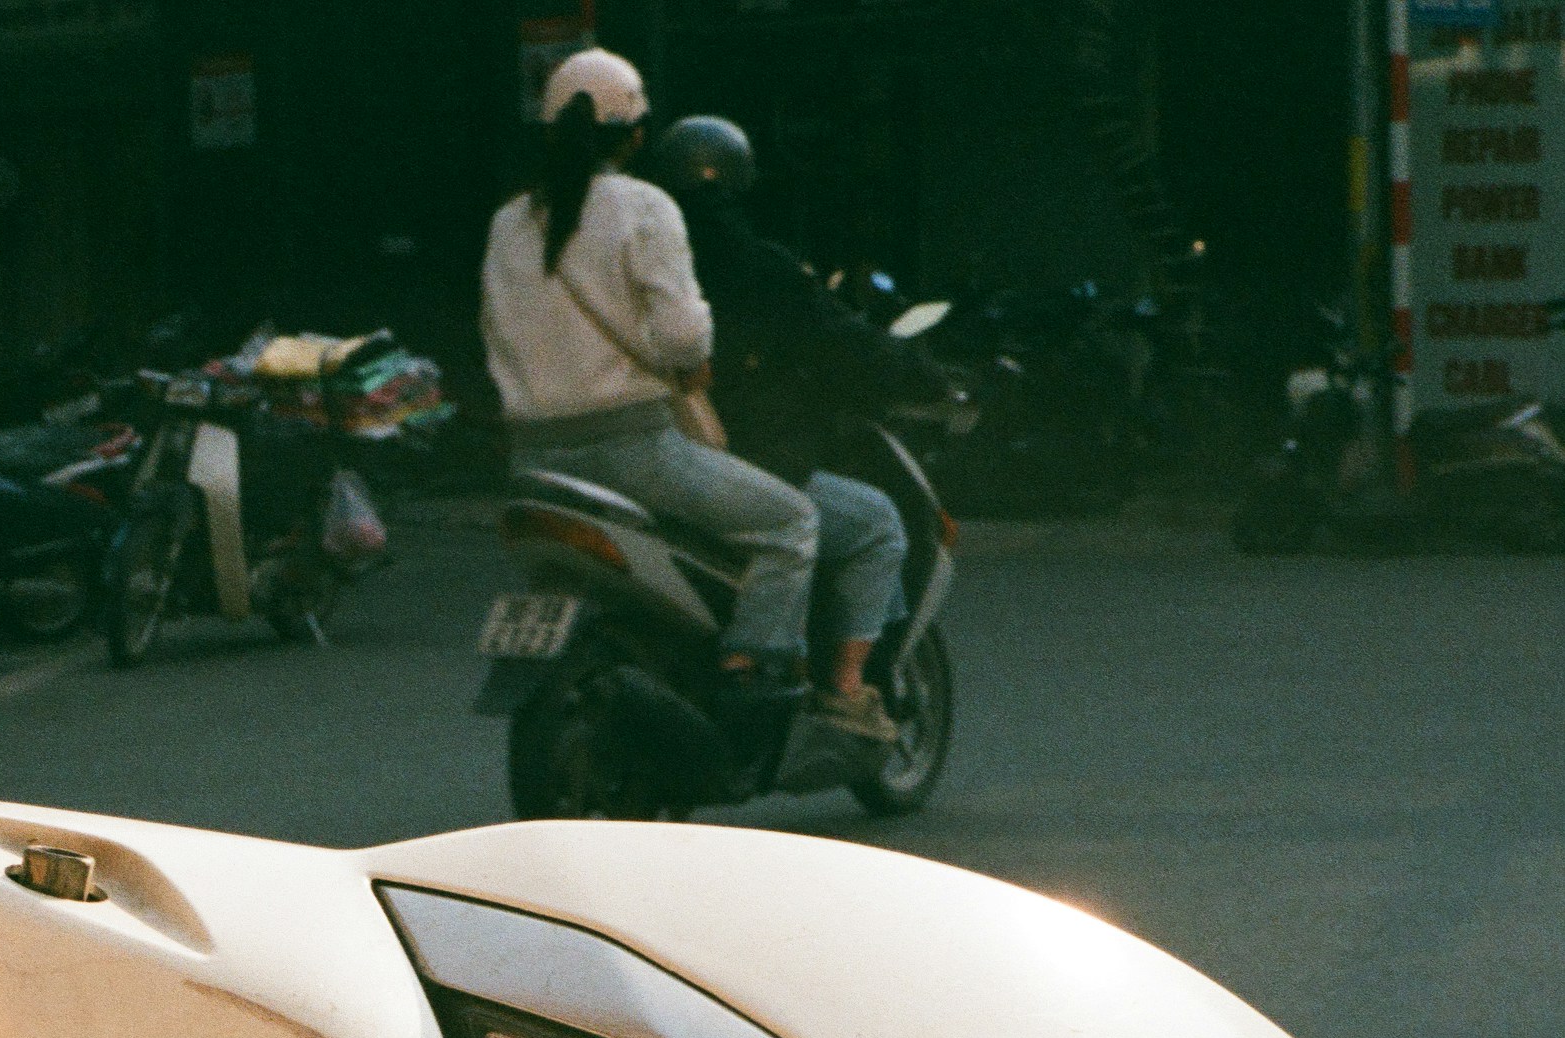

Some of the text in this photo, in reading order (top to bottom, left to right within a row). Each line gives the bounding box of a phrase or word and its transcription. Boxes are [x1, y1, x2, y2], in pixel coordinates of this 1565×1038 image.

[1448, 69, 1534, 105] PHONE
[1443, 127, 1541, 164] REPAIR
[1443, 184, 1540, 221] POWER
[1453, 245, 1526, 281] BANK
